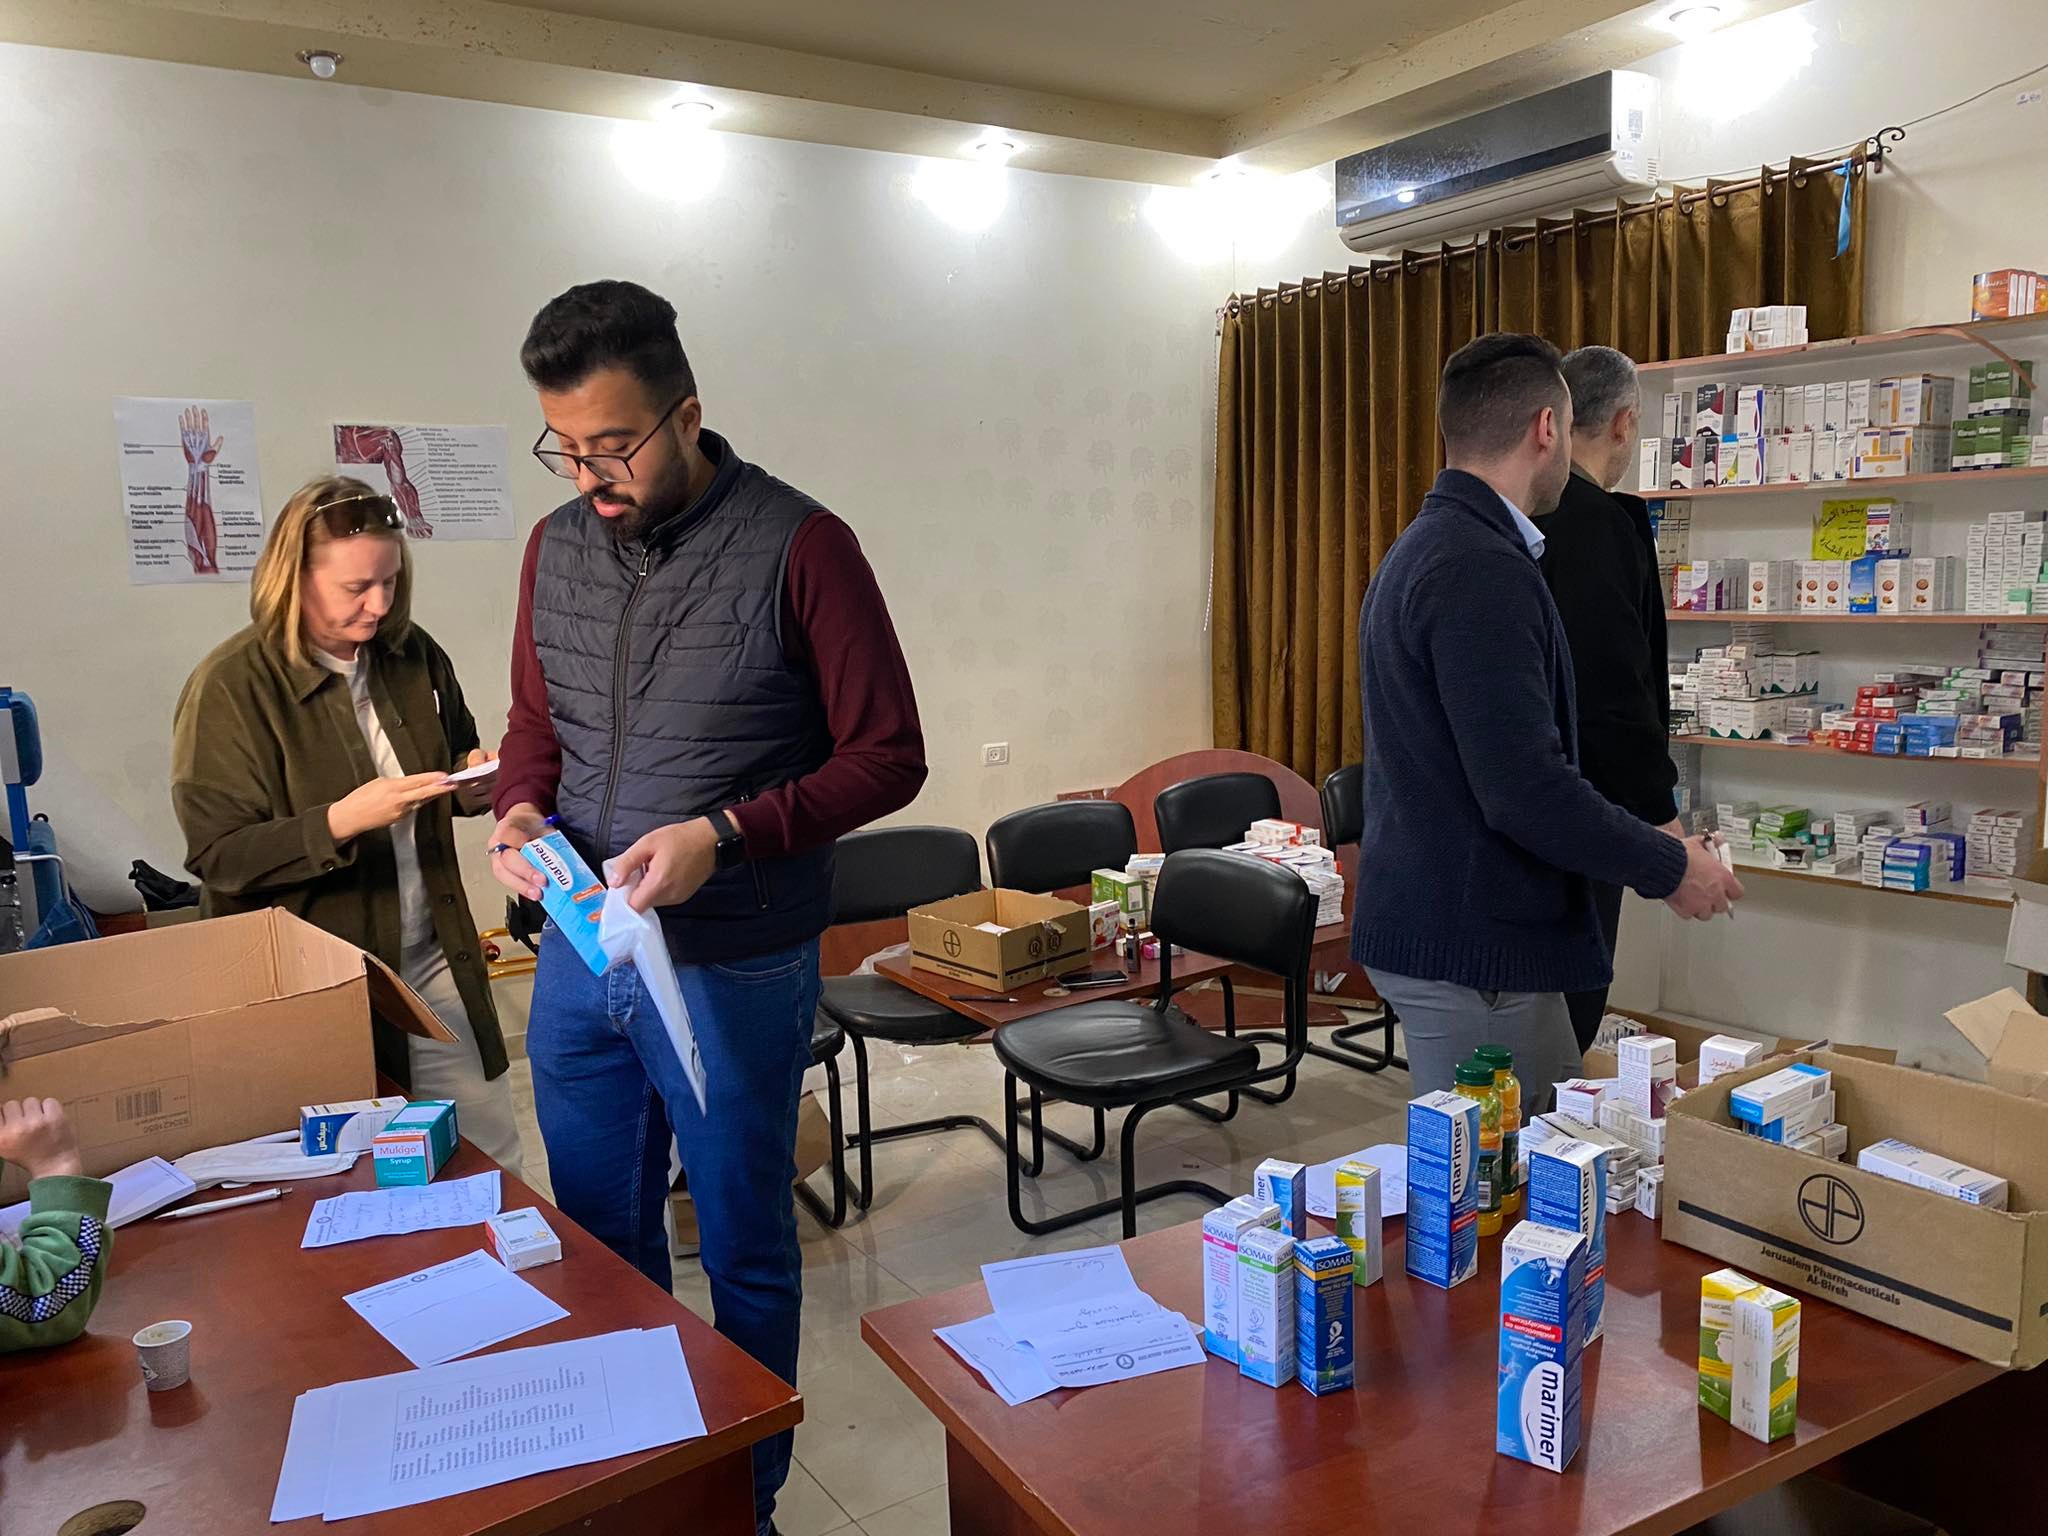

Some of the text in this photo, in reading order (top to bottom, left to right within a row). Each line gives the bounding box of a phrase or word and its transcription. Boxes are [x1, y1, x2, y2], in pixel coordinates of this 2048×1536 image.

[531, 843, 570, 886] marimer
[379, 1144, 417, 1156] Mukigo
[390, 1158, 412, 1166] Syrup
[1452, 1118, 1463, 1197] marimer
[1257, 1175, 1265, 1201] imer
[1581, 1169, 1589, 1250] arimer
[1204, 1223, 1235, 1242] ISOMAR
[1239, 1245, 1274, 1264] ISOMAR
[1296, 1250, 1314, 1268] OMAR
[1316, 1254, 1352, 1271] ISOMAR
[1761, 1246, 1901, 1306] Jerusalem Pharmaceuticals
[1806, 1273, 1849, 1298] Al-Bireh
[1540, 1369, 1561, 1465] marimer
